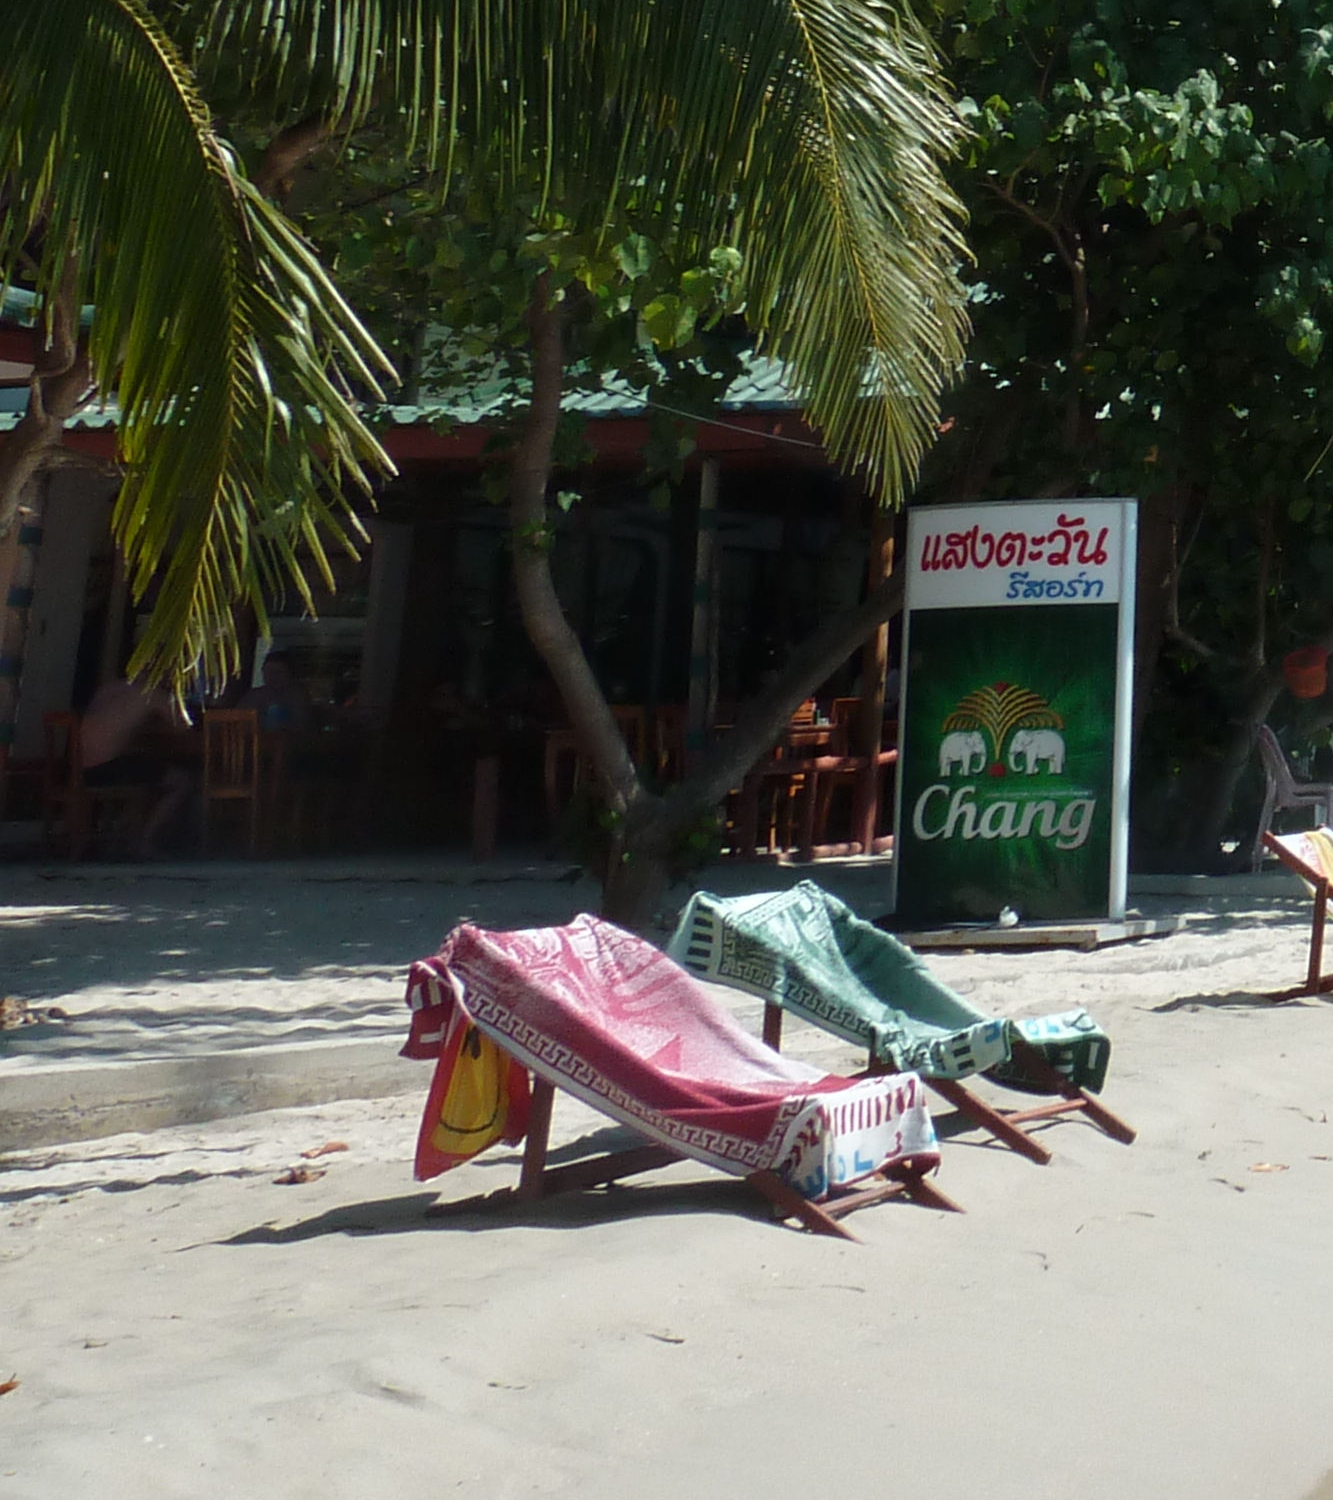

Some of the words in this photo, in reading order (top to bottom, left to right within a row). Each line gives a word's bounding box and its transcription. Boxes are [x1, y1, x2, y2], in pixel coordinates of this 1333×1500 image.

[921, 513, 1109, 572] แสงตะวัน
[1006, 571, 1104, 599] รีสอร์ท
[912, 784, 1097, 850] Chang
